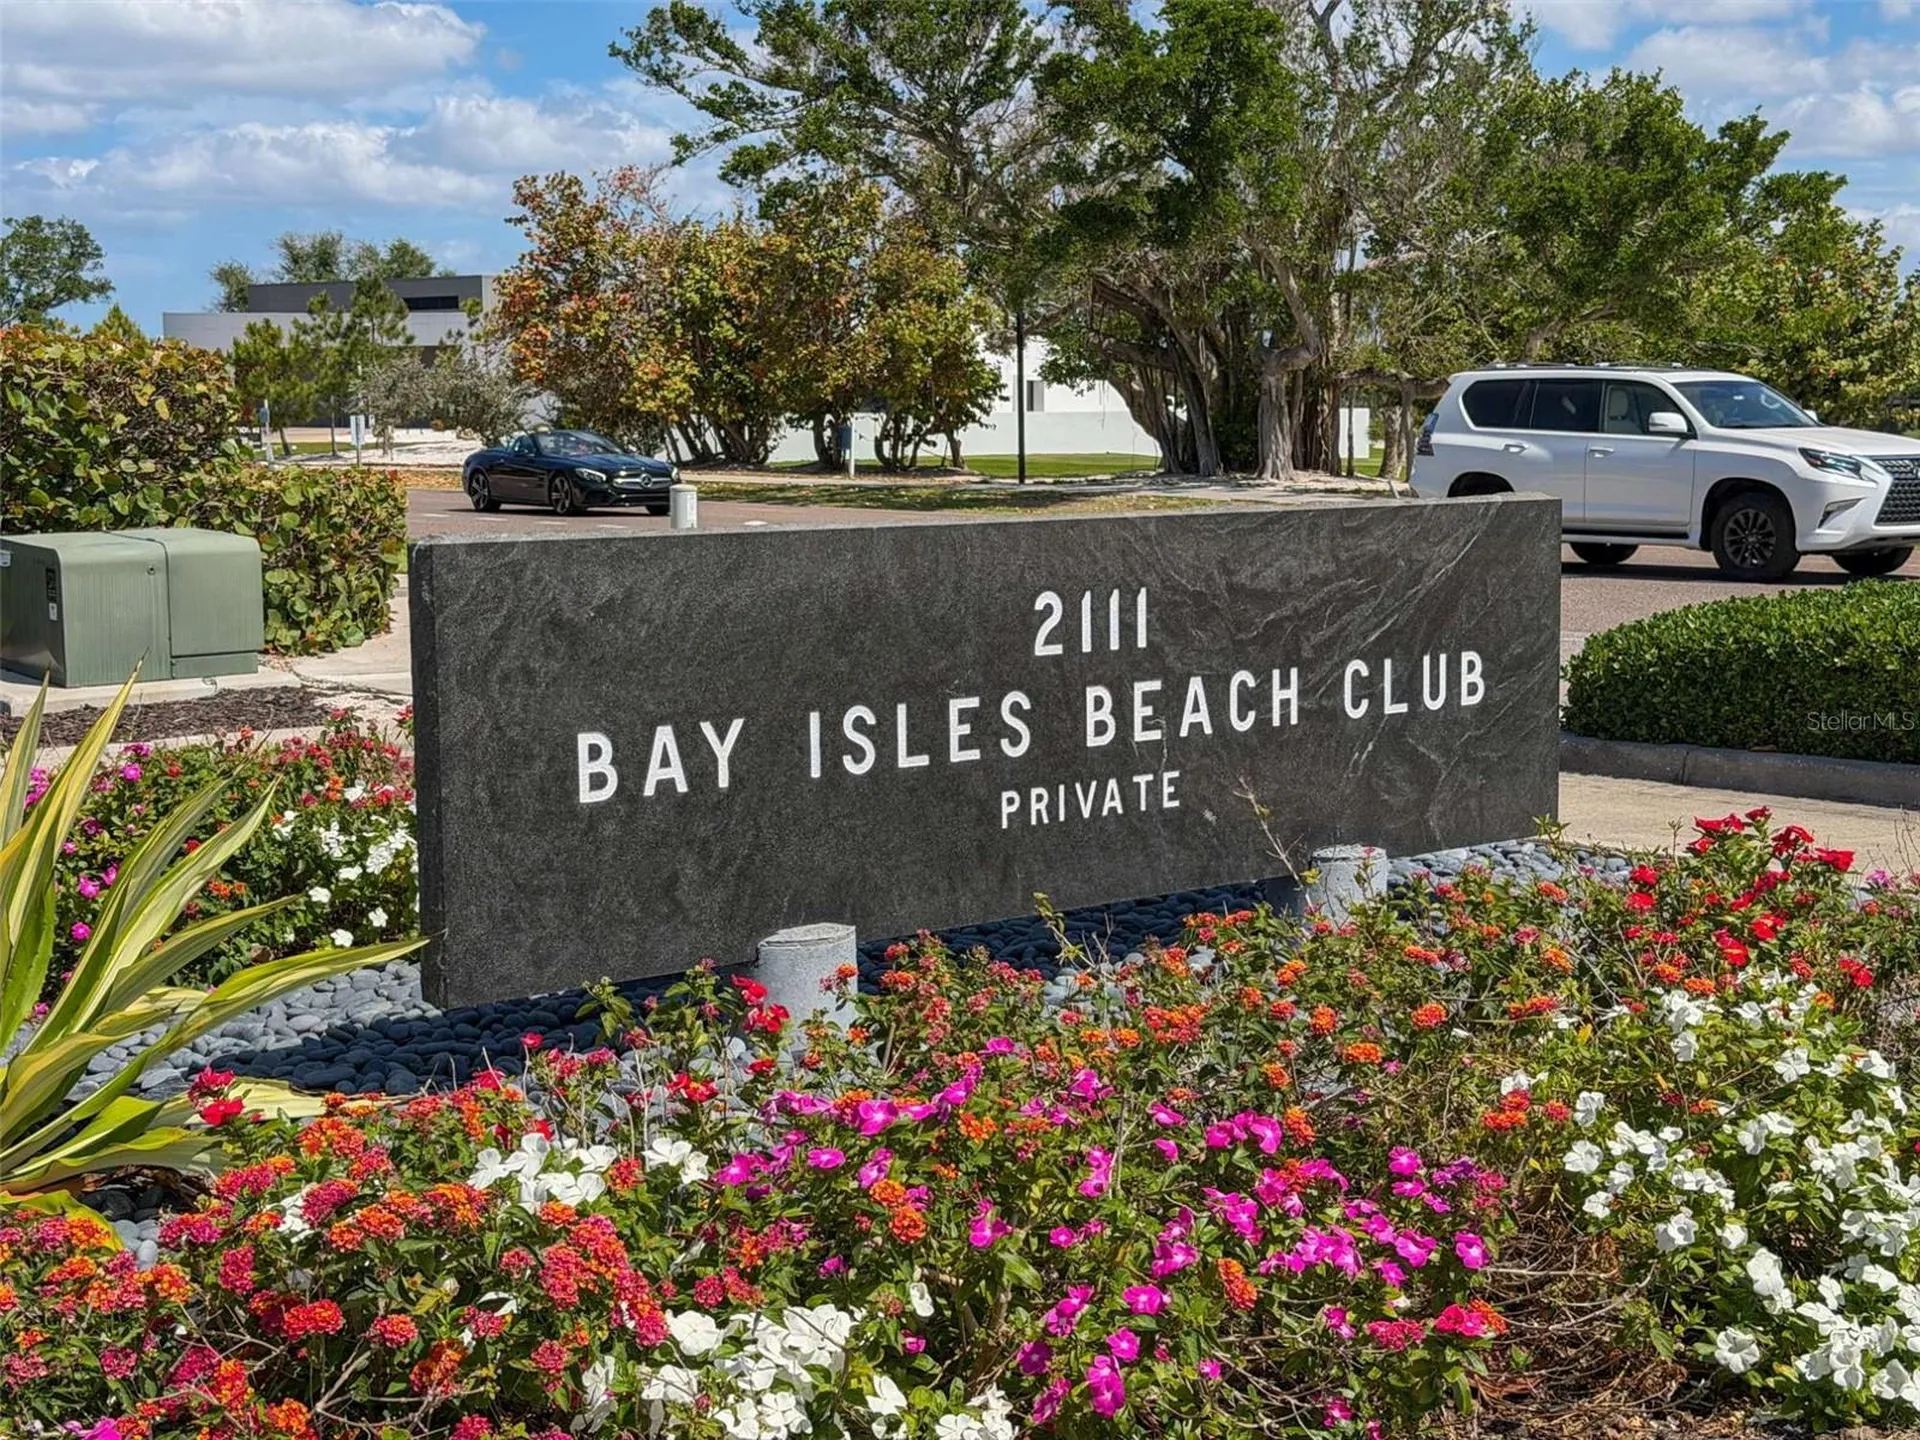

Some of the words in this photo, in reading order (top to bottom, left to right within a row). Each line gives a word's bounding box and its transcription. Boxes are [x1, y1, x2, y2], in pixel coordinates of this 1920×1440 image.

[1034, 588, 1148, 657] 2111
[576, 718, 745, 804] BAY
[808, 690, 1032, 779] ISLES
[1085, 667, 1300, 748] BEACH
[1342, 650, 1486, 720] CLUB
[1000, 770, 1181, 830] PRIVATE
